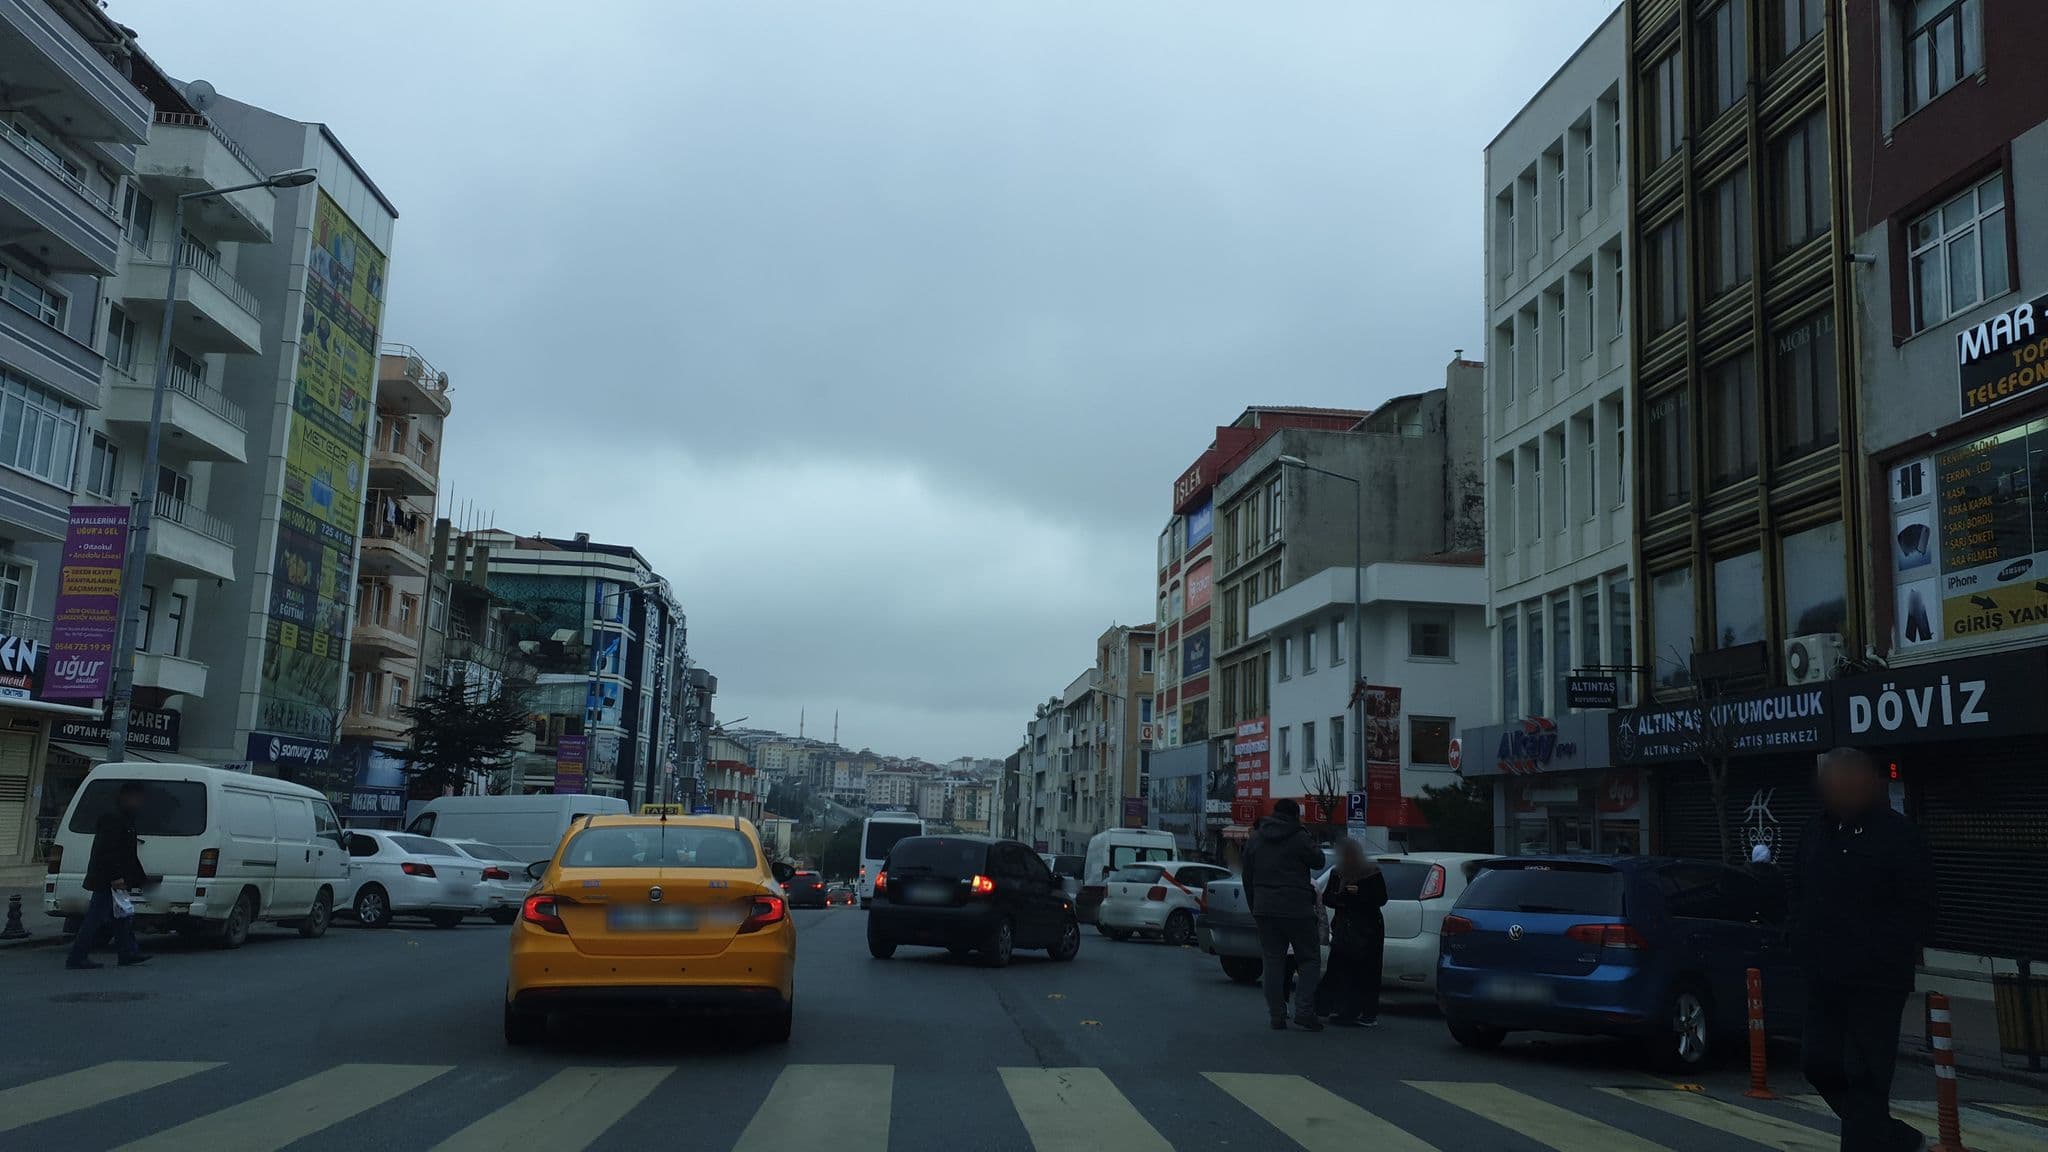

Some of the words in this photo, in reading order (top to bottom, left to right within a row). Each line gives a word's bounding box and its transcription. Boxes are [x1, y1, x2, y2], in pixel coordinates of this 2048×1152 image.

[1960, 303, 2035, 365] MAR
[1948, 574, 1978, 589] iPhone
[1953, 611, 2003, 634] GİRİŞ
[54, 655, 105, 681] uğur
[1848, 674, 1990, 734] DÖVİZ
[1766, 726, 1818, 745] MERKEZİ
